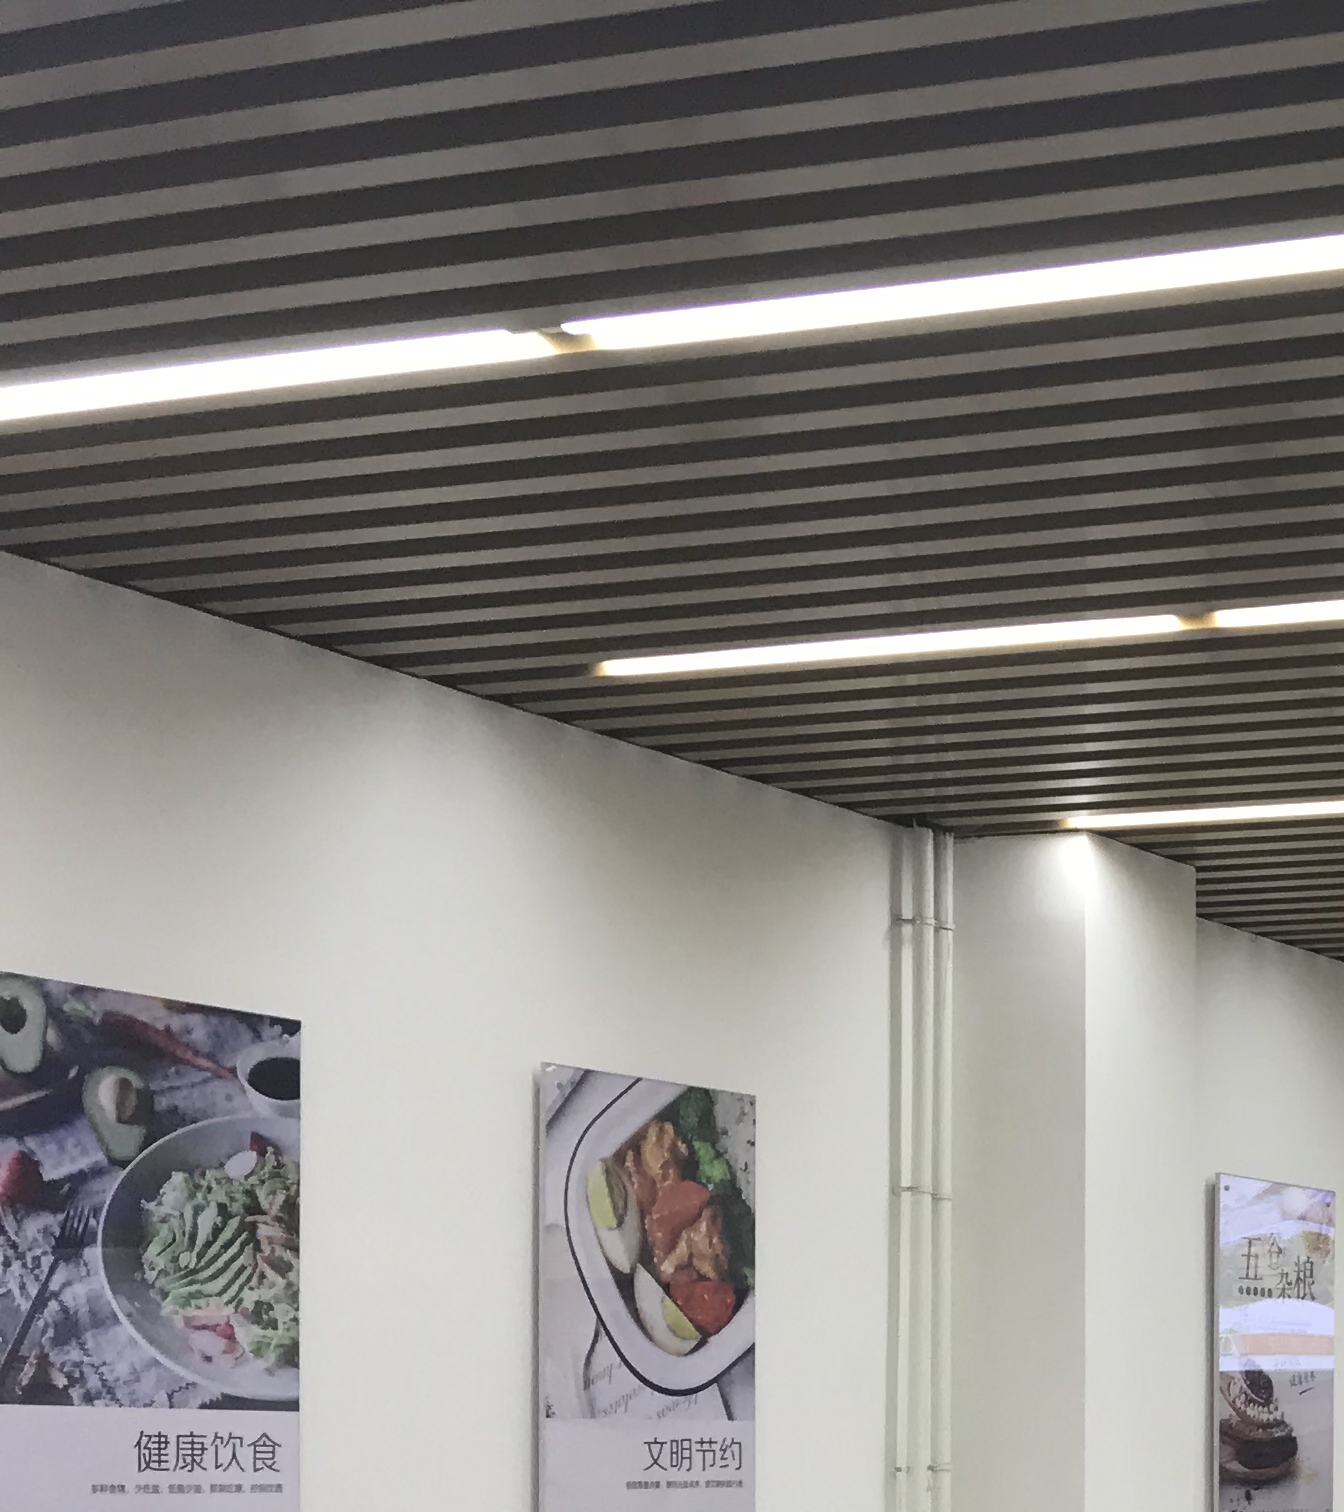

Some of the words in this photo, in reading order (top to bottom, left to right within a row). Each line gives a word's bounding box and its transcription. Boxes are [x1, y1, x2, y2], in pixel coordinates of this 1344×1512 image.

[134, 1430, 282, 1472] 健康饮食
[643, 1437, 743, 1472] 文明节约
